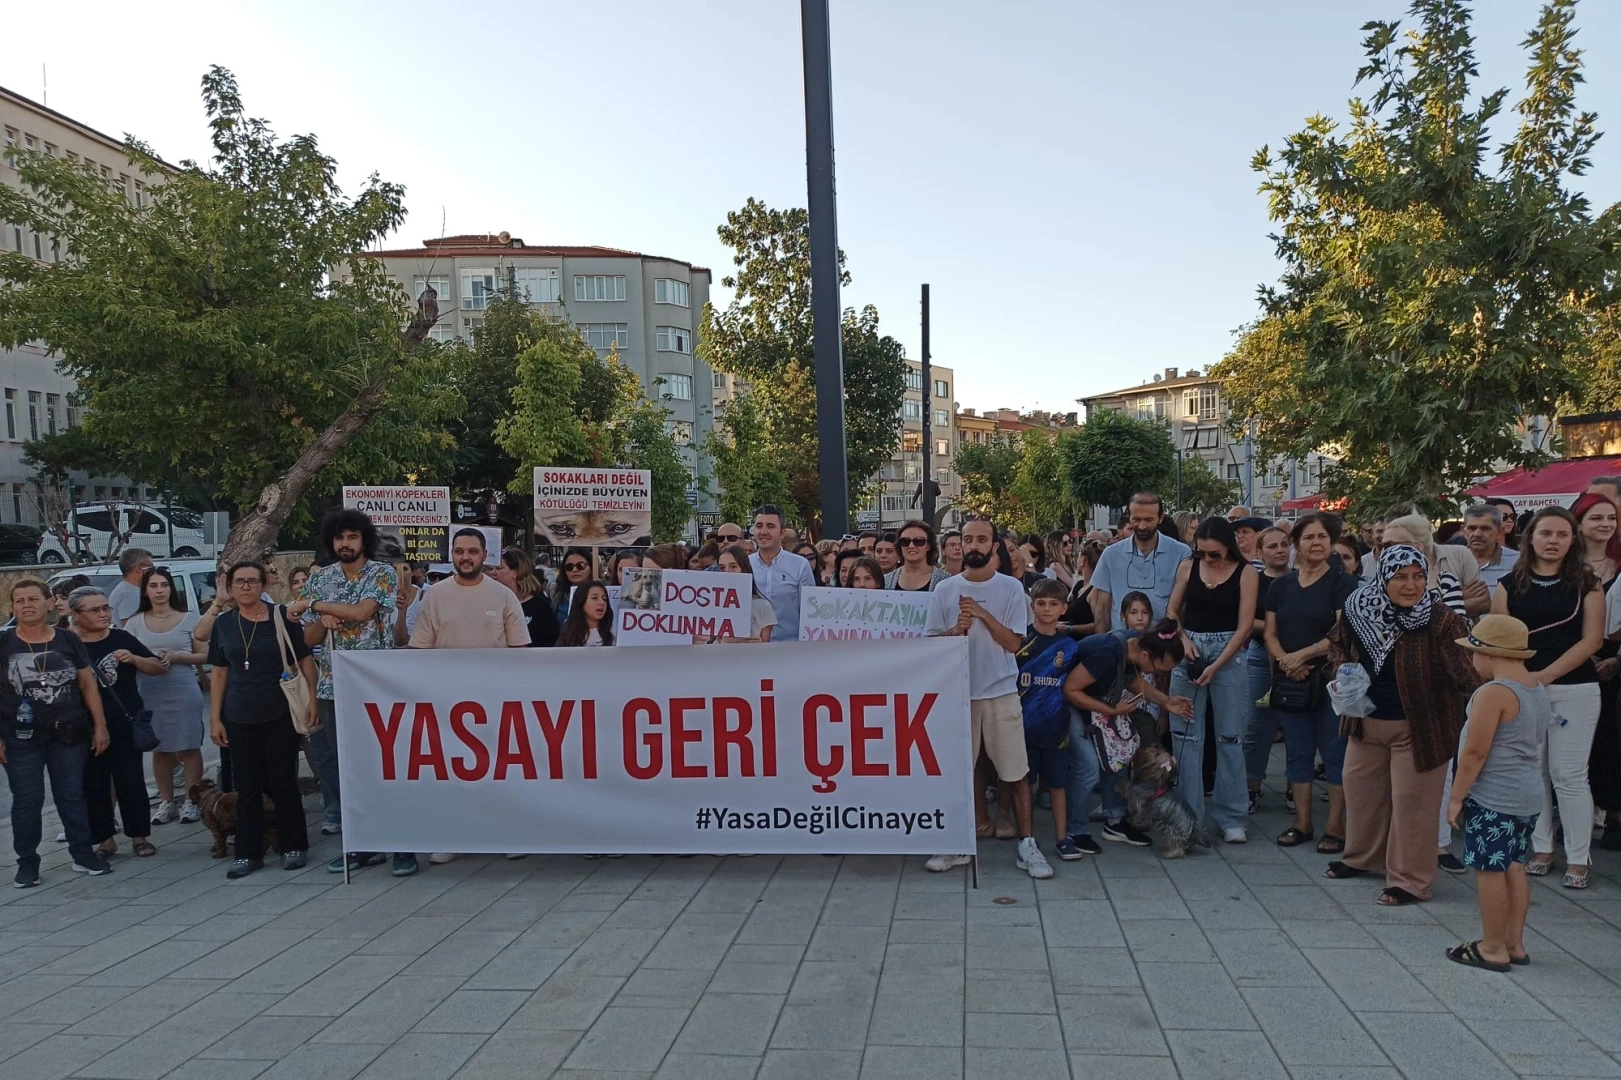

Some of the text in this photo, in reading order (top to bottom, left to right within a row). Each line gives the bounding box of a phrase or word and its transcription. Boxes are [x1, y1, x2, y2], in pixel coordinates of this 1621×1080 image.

[543, 472, 644, 486] SOKAKLARI DEĞİL
[346, 489, 446, 499] EKONOMİYİ KÖPEKLERİ
[537, 485, 648, 497] İÇİNİZDE BÜYÜYEN
[357, 501, 437, 512] CANLI CANLI
[540, 499, 645, 510] KÖTÜLÜĞÜ TEMİZLEYİN!
[399, 527, 445, 536] ONLAR DA
[407, 539, 437, 548] Bİ CAN
[405, 553, 441, 563] TAŞIYOR
[665, 582, 741, 609] DOSTA
[622, 612, 736, 637] DOKUNMA
[364, 679, 942, 793] YASAYI GERİ ÇEK
[696, 805, 945, 834] #YasaDeğilCinayet
